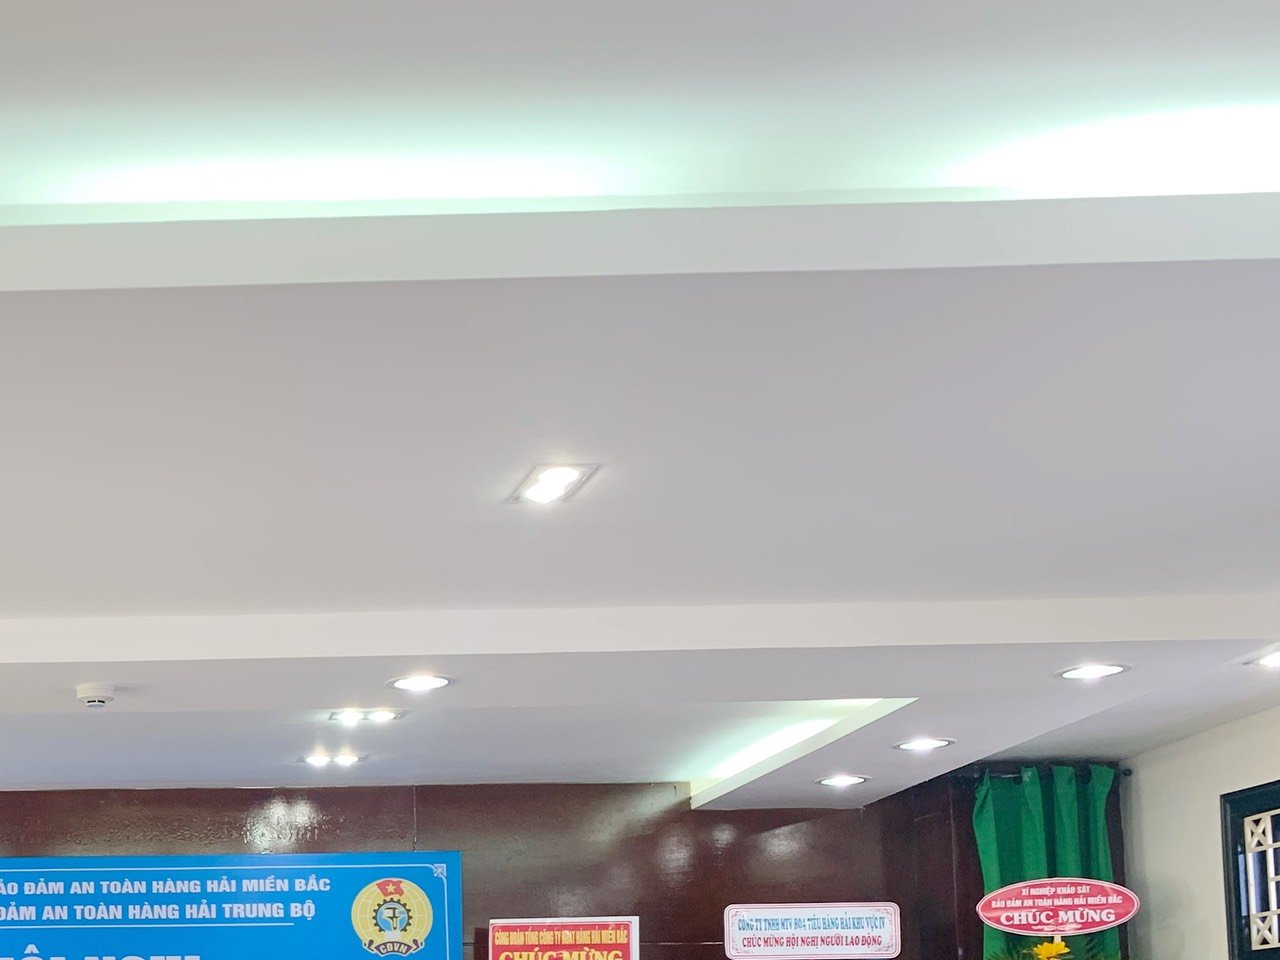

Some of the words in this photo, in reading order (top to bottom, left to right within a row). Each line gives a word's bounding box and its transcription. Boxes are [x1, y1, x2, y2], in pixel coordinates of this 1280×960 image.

[23, 877, 64, 895] ĐẢM
[70, 881, 95, 894] AN
[100, 878, 146, 893] TOÀN
[152, 878, 201, 893] HÀNG
[206, 875, 236, 892] HẢI
[242, 874, 289, 892] MIỀN
[294, 873, 331, 891] BẮC
[42, 906, 68, 920] AN
[73, 902, 122, 920] TOÀN
[128, 902, 179, 919] HÀNG
[185, 899, 217, 919] HẢI
[222, 903, 284, 919] TRUNG
[290, 899, 316, 920] BỘ
[1000, 909, 1054, 925] CHÚC
[1058, 907, 1116, 923] MỪNG
[742, 934, 762, 947] CHÚC
[763, 934, 784, 947] MỪNG
[786, 933, 799, 949] HỘI
[800, 936, 819, 949] NGHỊ
[820, 933, 843, 946] NGƯỜI
[845, 935, 860, 946] LAO
[861, 932, 882, 948] ĐỘNG
